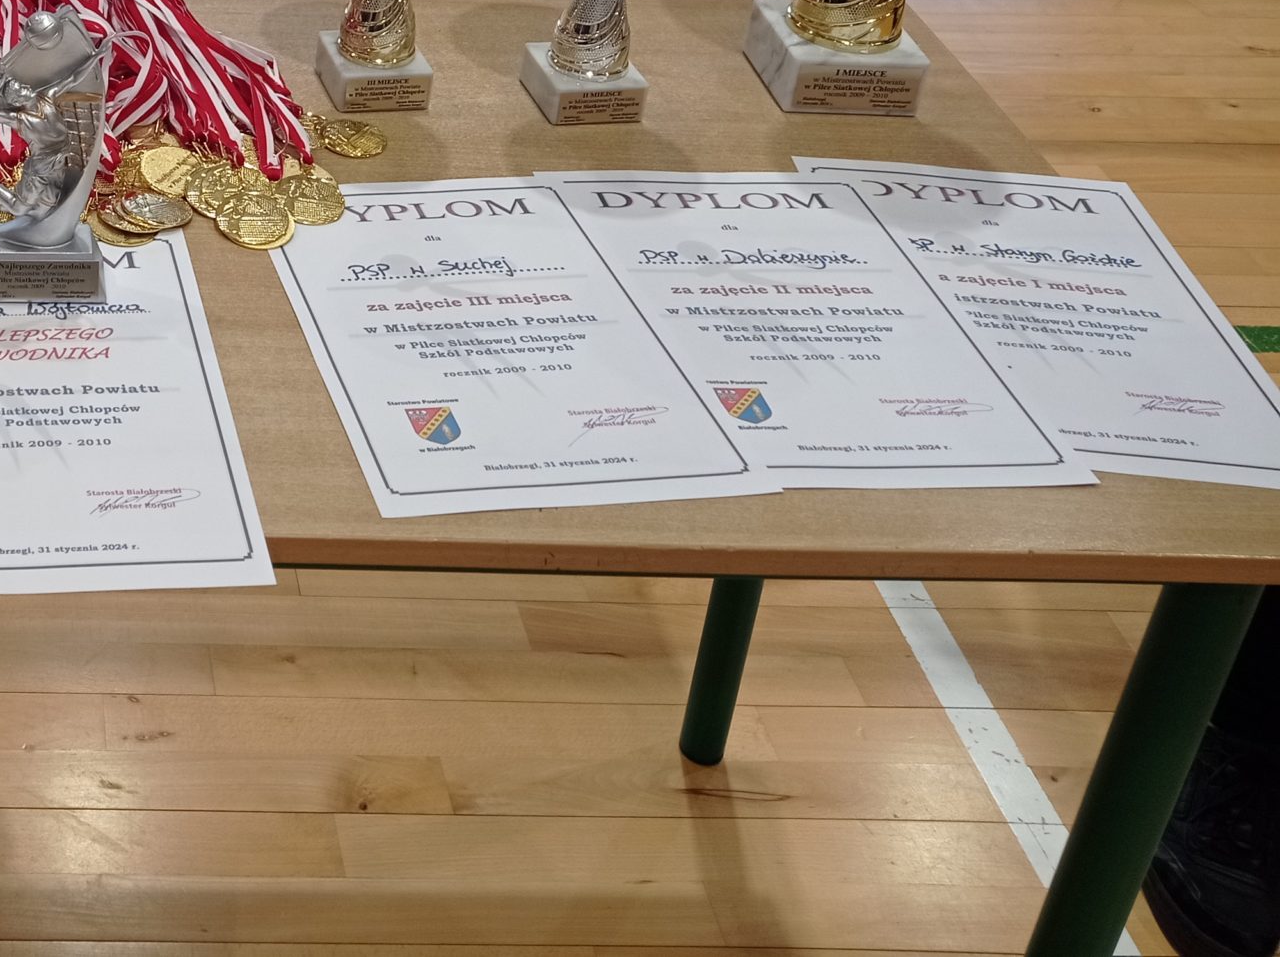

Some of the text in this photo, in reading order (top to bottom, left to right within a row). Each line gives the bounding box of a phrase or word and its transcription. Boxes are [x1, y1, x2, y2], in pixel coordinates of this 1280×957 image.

[842, 69, 888, 77] MIEJSCE
[592, 191, 833, 210] DYPLOM
[344, 197, 536, 223] YPLOM
[721, 224, 739, 232] dla
[908, 238, 935, 251] SP
[639, 249, 678, 263] PSP
[0, 263, 45, 271] Najlepszego
[348, 263, 391, 280] PSP
[438, 256, 514, 277] Suchej
[671, 285, 873, 297] za zajęcie II miejsca
[956, 275, 1027, 288] zajęcie
[1032, 280, 1042, 288] I
[1047, 282, 1127, 296] miejsca
[367, 292, 572, 312] za zajęcie III miejsca
[954, 293, 1162, 318] istrzostwach Powiatu
[686, 306, 824, 316] Mistrzostwach
[827, 306, 905, 316] Powiatu
[363, 313, 598, 334] w Mistrzostwach Powiatu
[1002, 314, 1075, 328] Siatkowej
[752, 324, 823, 335] Siatkowej
[1019, 324, 1135, 341] Podstawowych
[447, 336, 517, 347] Siatkowej
[771, 334, 882, 344] Podstawowych
[465, 343, 575, 357] Podstawowych
[443, 363, 572, 378] rocznik 2009 2010
[81, 384, 160, 395] Powiatu
[5, 416, 122, 429] Podstawowych
[28, 439, 63, 448] 2009
[76, 438, 111, 447] 2010
[86, 489, 124, 497] Starosta
[38, 545, 51, 554] 31
[54, 544, 99, 555] stycznia
[101, 543, 128, 552] 2024
